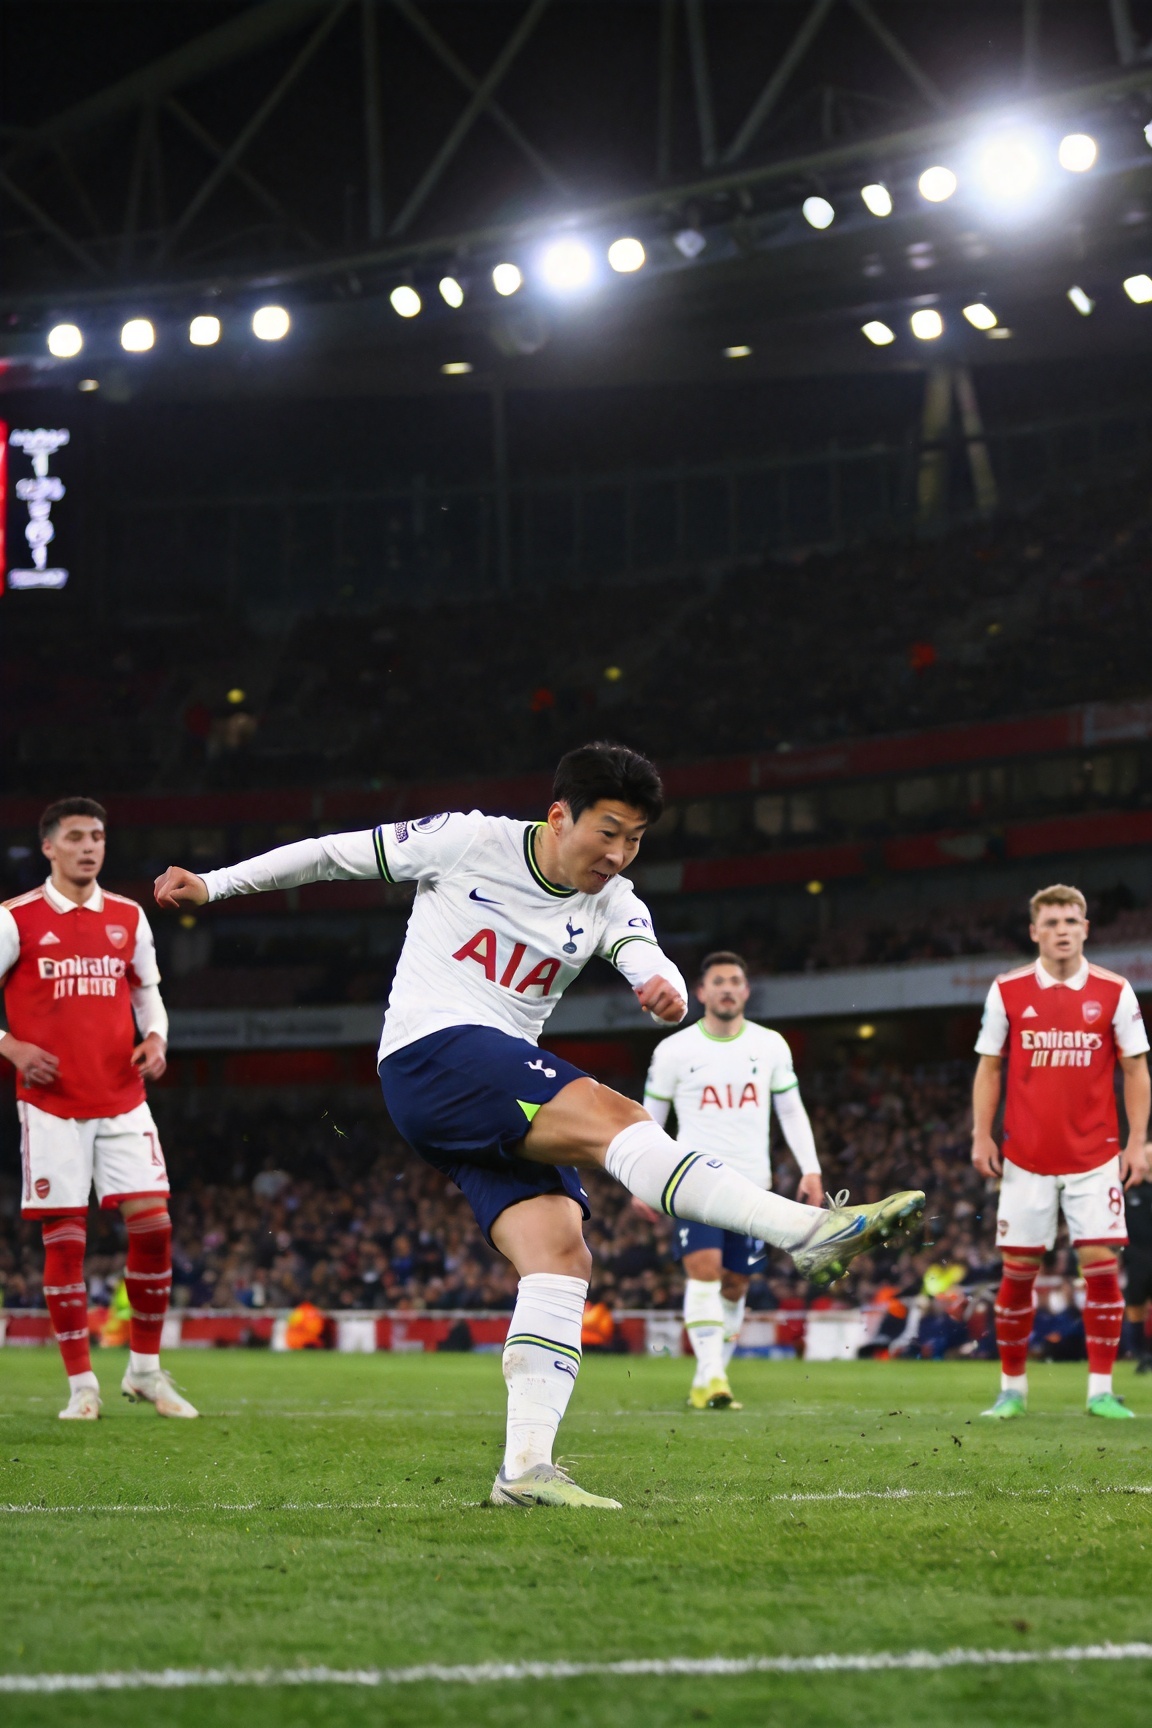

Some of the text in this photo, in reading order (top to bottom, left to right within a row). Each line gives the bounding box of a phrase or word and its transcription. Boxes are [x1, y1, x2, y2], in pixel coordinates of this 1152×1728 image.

[451, 928, 561, 997] AIA
[699, 1082, 759, 1110] AIA
[1108, 1187, 1122, 1216] 8
